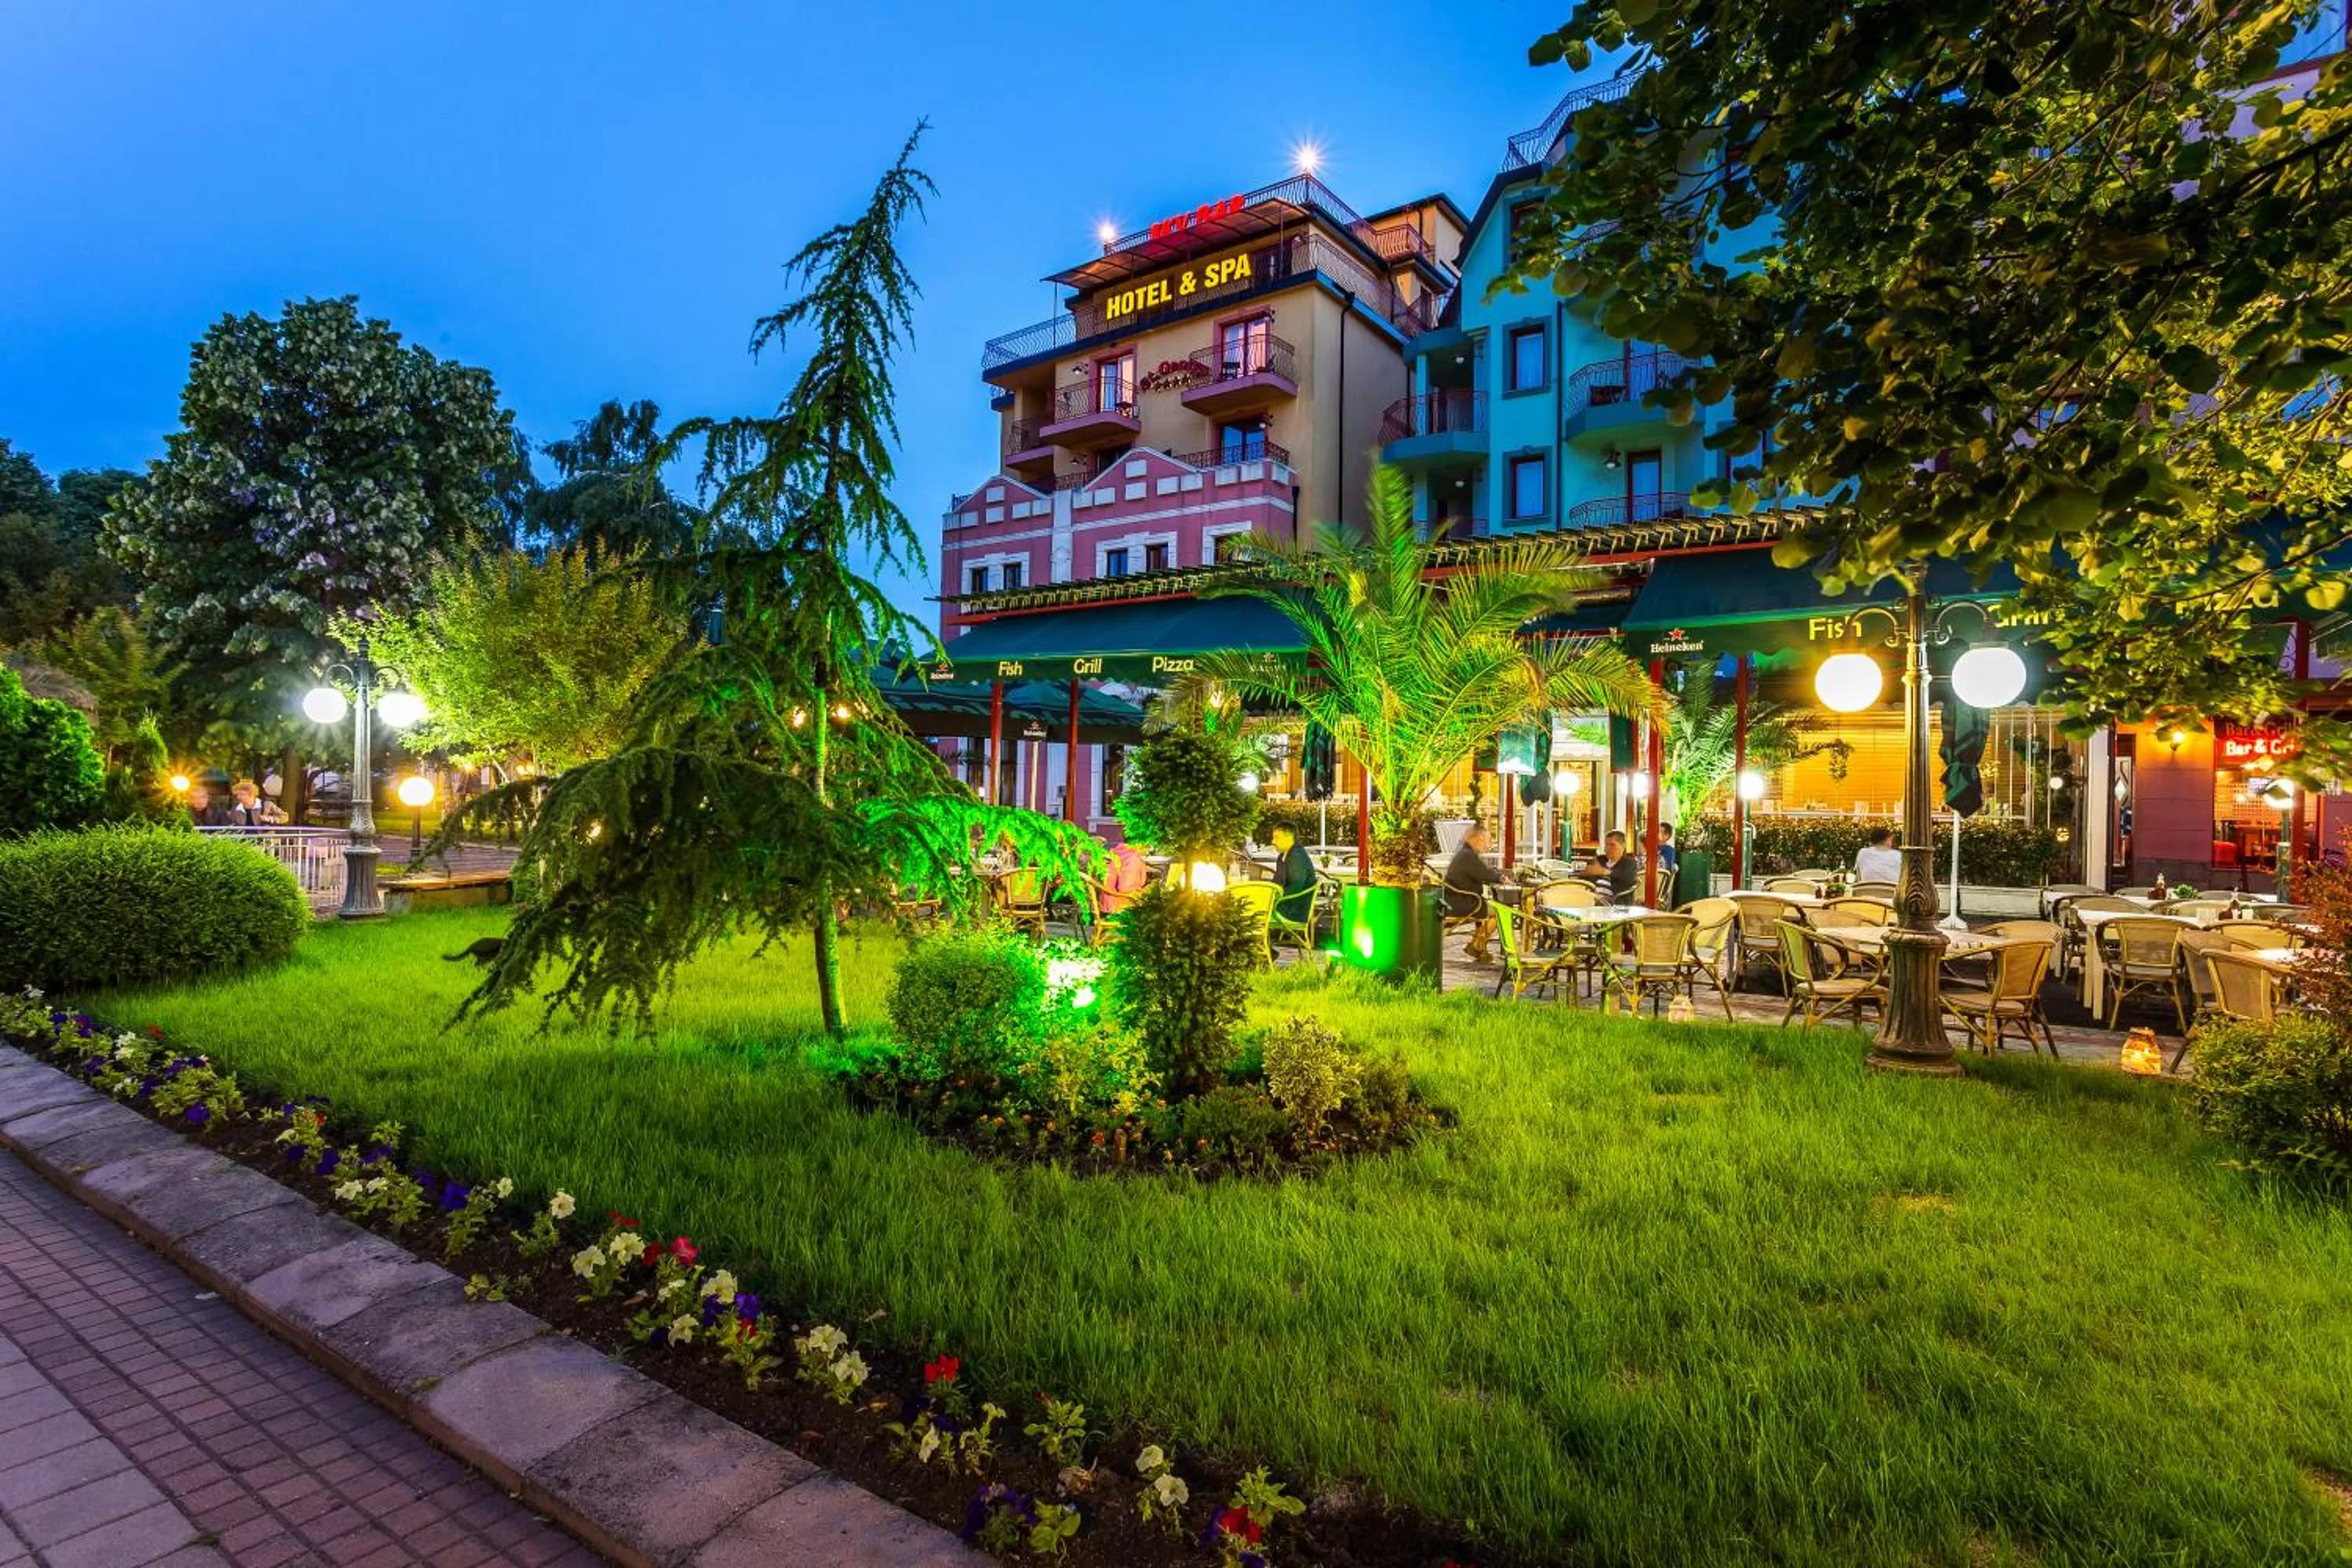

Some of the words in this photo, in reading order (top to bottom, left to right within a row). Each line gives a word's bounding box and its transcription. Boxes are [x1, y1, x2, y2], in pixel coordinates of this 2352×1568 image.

[1106, 280, 1172, 320] HOTEL
[1179, 271, 1197, 296] &
[1204, 253, 1251, 288] SPA
[1809, 615, 1862, 640] Fish
[1650, 641, 1704, 653] Heineken
[998, 660, 1023, 677] Fish
[1073, 658, 1102, 673] Grill
[1152, 656, 1194, 673] Pizza
[2226, 740, 2252, 756] Bar
[2254, 738, 2268, 753] &
